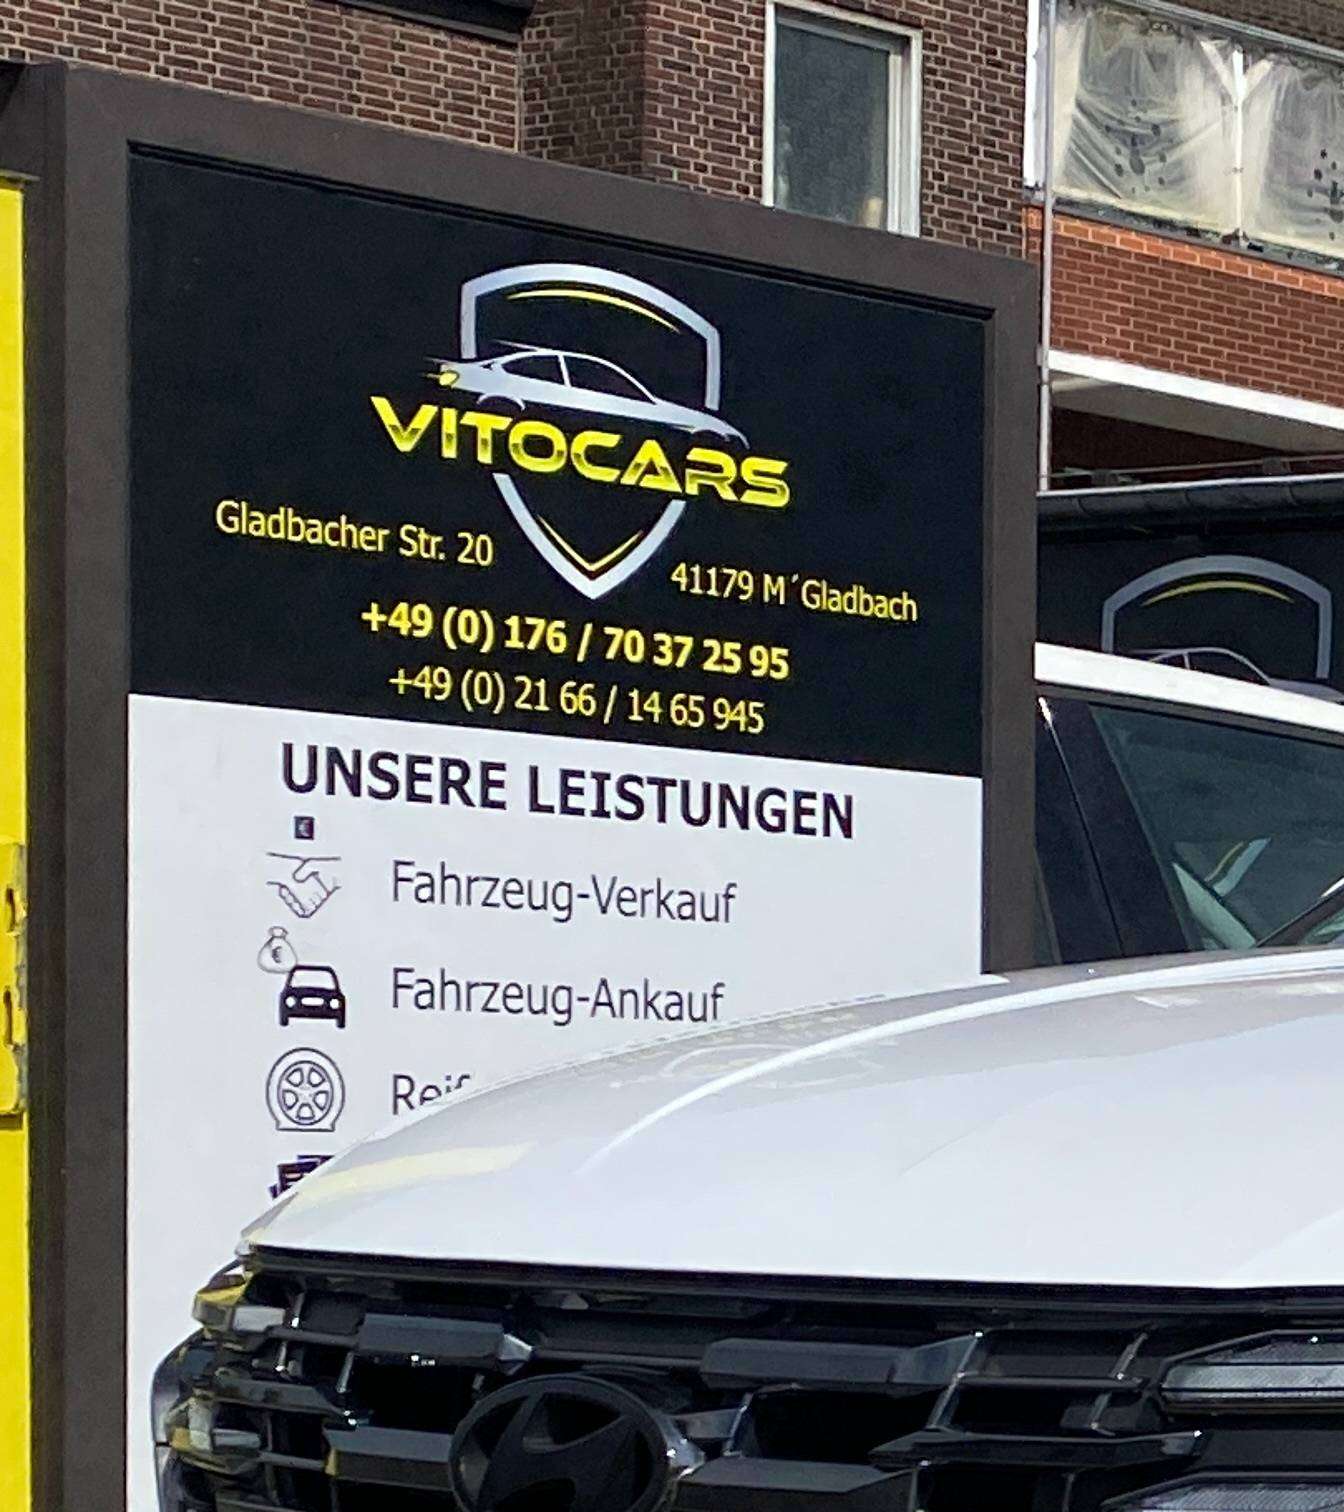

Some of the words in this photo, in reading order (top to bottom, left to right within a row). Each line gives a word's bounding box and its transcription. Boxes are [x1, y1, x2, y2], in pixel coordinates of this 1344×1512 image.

[371, 397, 792, 508] VITOCARS
[216, 500, 390, 551] Gladbacher
[399, 524, 447, 561] Str.
[458, 531, 494, 566] 20
[671, 562, 754, 600] 41179
[361, 601, 434, 638] +49
[443, 606, 495, 653] (0)
[504, 616, 568, 654] 176
[577, 623, 593, 663] /
[603, 627, 645, 663] 70
[653, 632, 694, 668] 37
[702, 639, 742, 674] 25
[750, 645, 790, 680] 95
[389, 665, 453, 701] +49
[461, 669, 505, 714] (0)
[514, 675, 550, 711] 21
[560, 682, 597, 716] 66
[604, 685, 618, 724] /
[629, 688, 663, 723] 14
[670, 693, 705, 727] 65
[712, 697, 765, 734] 945
[282, 742, 507, 811] UNSERE
[529, 765, 853, 839] LEISTUNGEN
[393, 860, 737, 924] Fahrzeug-Verkauf
[392, 967, 725, 1027] Fahrzeug-Ankauf
